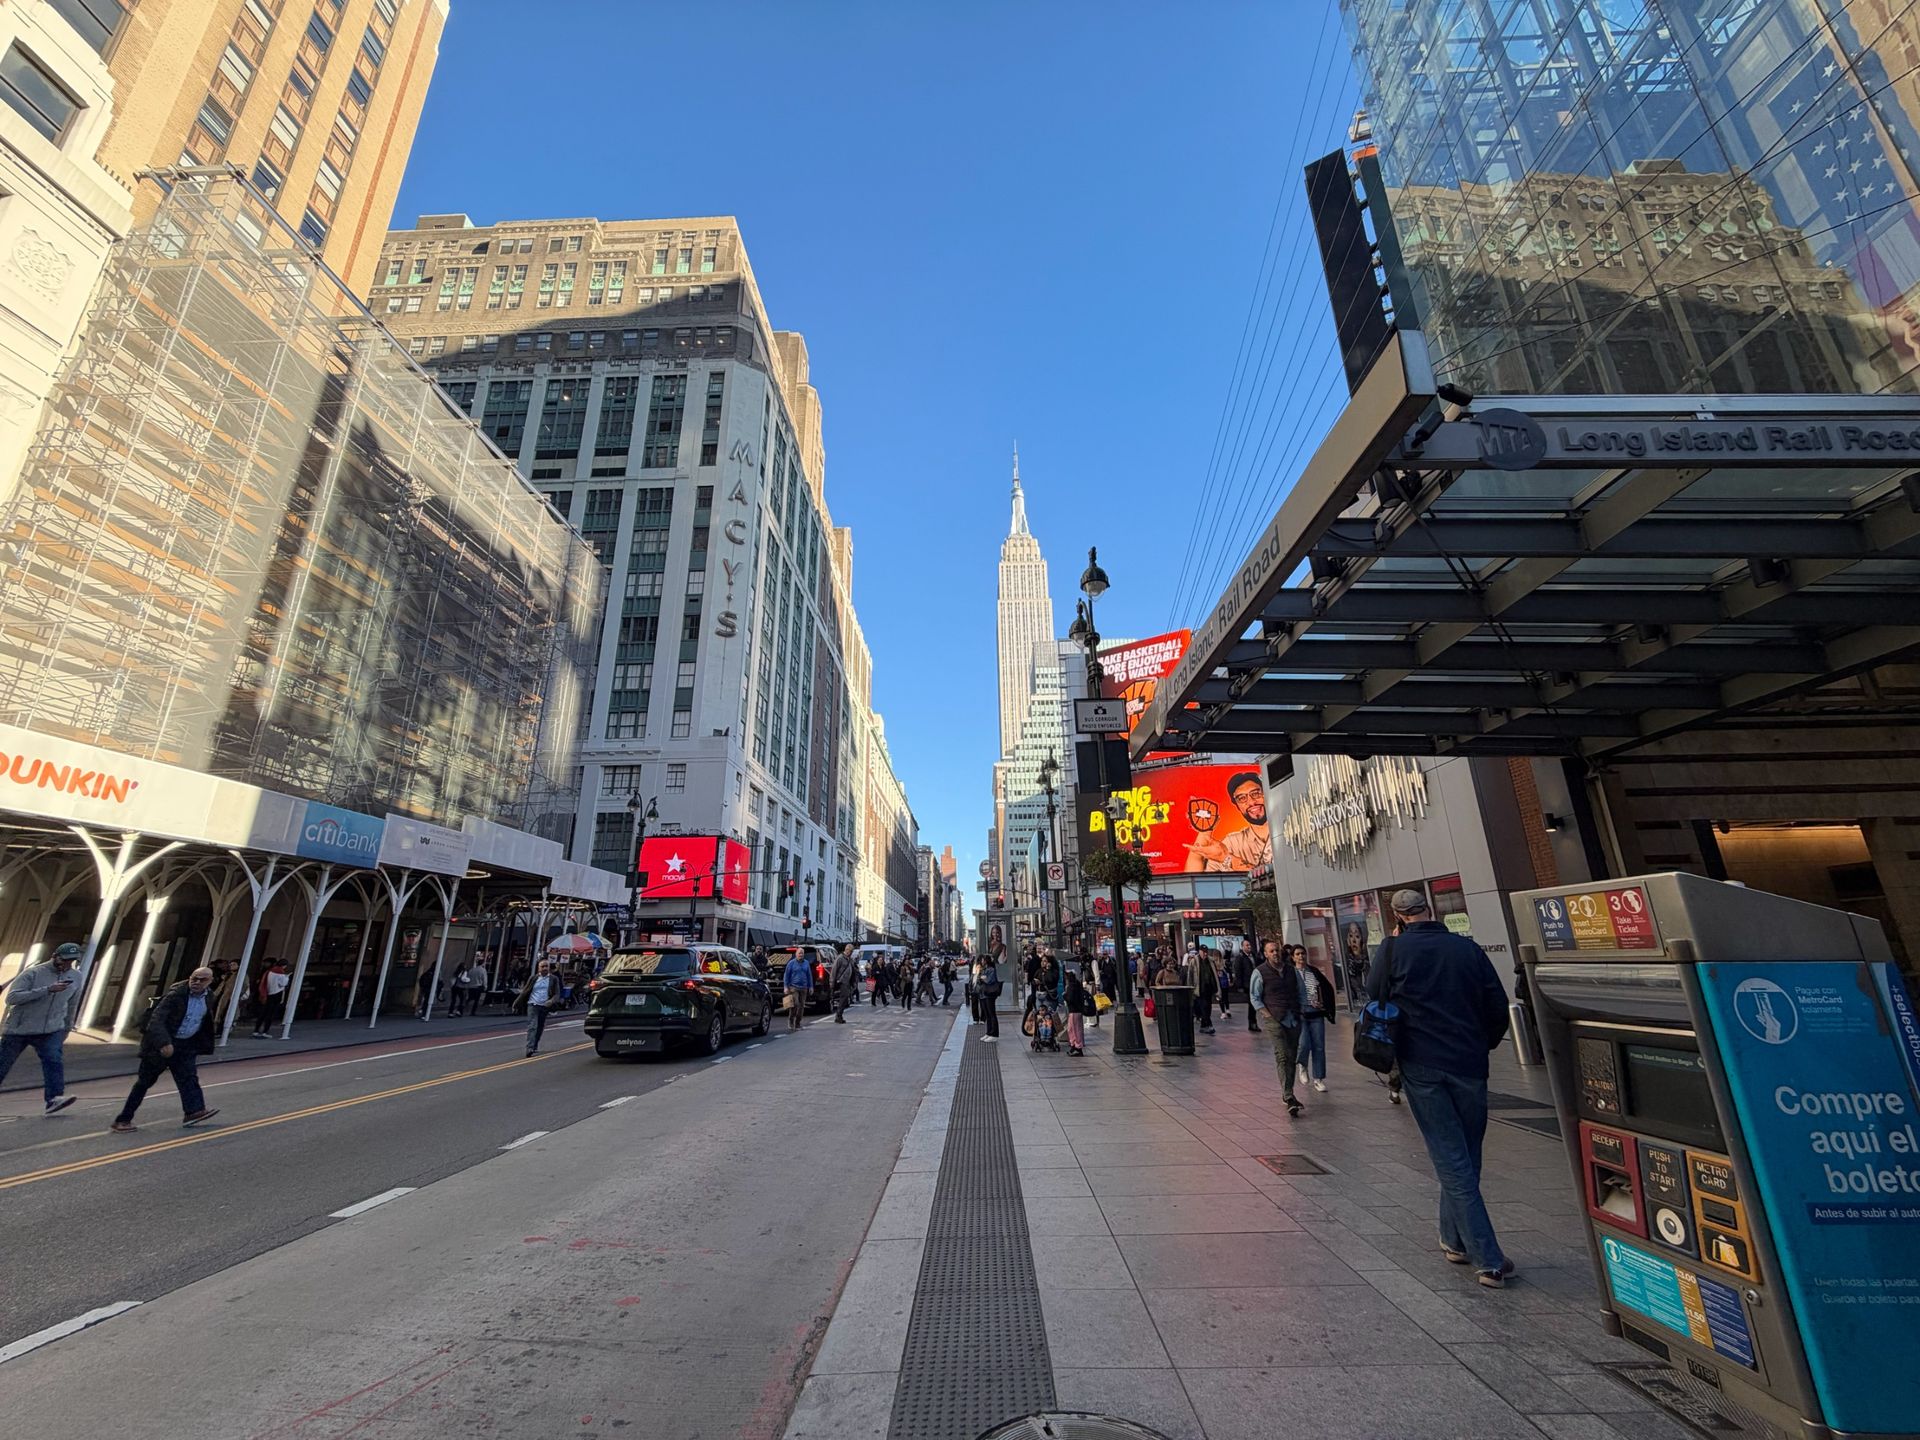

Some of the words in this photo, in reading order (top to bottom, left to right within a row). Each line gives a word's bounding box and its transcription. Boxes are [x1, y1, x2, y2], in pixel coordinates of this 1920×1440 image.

[1558, 427, 1647, 457] Long
[1650, 426, 1758, 452] Island
[1762, 426, 1833, 451] Rail
[1168, 667, 1188, 698] Long
[1188, 622, 1214, 675] Island
[1218, 585, 1240, 632] Rail
[1242, 524, 1281, 600] Road
[1123, 639, 1182, 660] BASKETBALL
[1127, 649, 1181, 670] ENJOYABLE
[1114, 672, 1126, 683] TO
[1309, 795, 1366, 832] SWAROVSKI
[305, 822, 379, 854] citibank
[1539, 905, 1547, 917] 1
[1569, 901, 1579, 914] 2
[1610, 896, 1621, 911] 3
[1543, 922, 1558, 930] Push
[1615, 916, 1632, 924] Take
[1202, 927, 1226, 935] PINK
[1575, 928, 1608, 936] MetroCard
[1618, 925, 1640, 934] Ticket
[1795, 986, 1821, 996] Pague
[1797, 995, 1843, 1004] MetroCard
[1775, 1086, 1905, 1121] Compre
[1591, 1133, 1621, 1149] RECEIPT
[1810, 1123, 1882, 1160] aquí
[1888, 1124, 1920, 1153] el
[1649, 1150, 1671, 1163] PUSH
[1655, 1163, 1667, 1173] TO
[1696, 1161, 1728, 1178] METRO
[1650, 1172, 1676, 1188] START
[1701, 1175, 1727, 1190] CARD
[1815, 1207, 1845, 1218] Antes
[1846, 1207, 1860, 1218] de
[1861, 1207, 1887, 1218] subir
[1889, 1207, 1899, 1218] al
